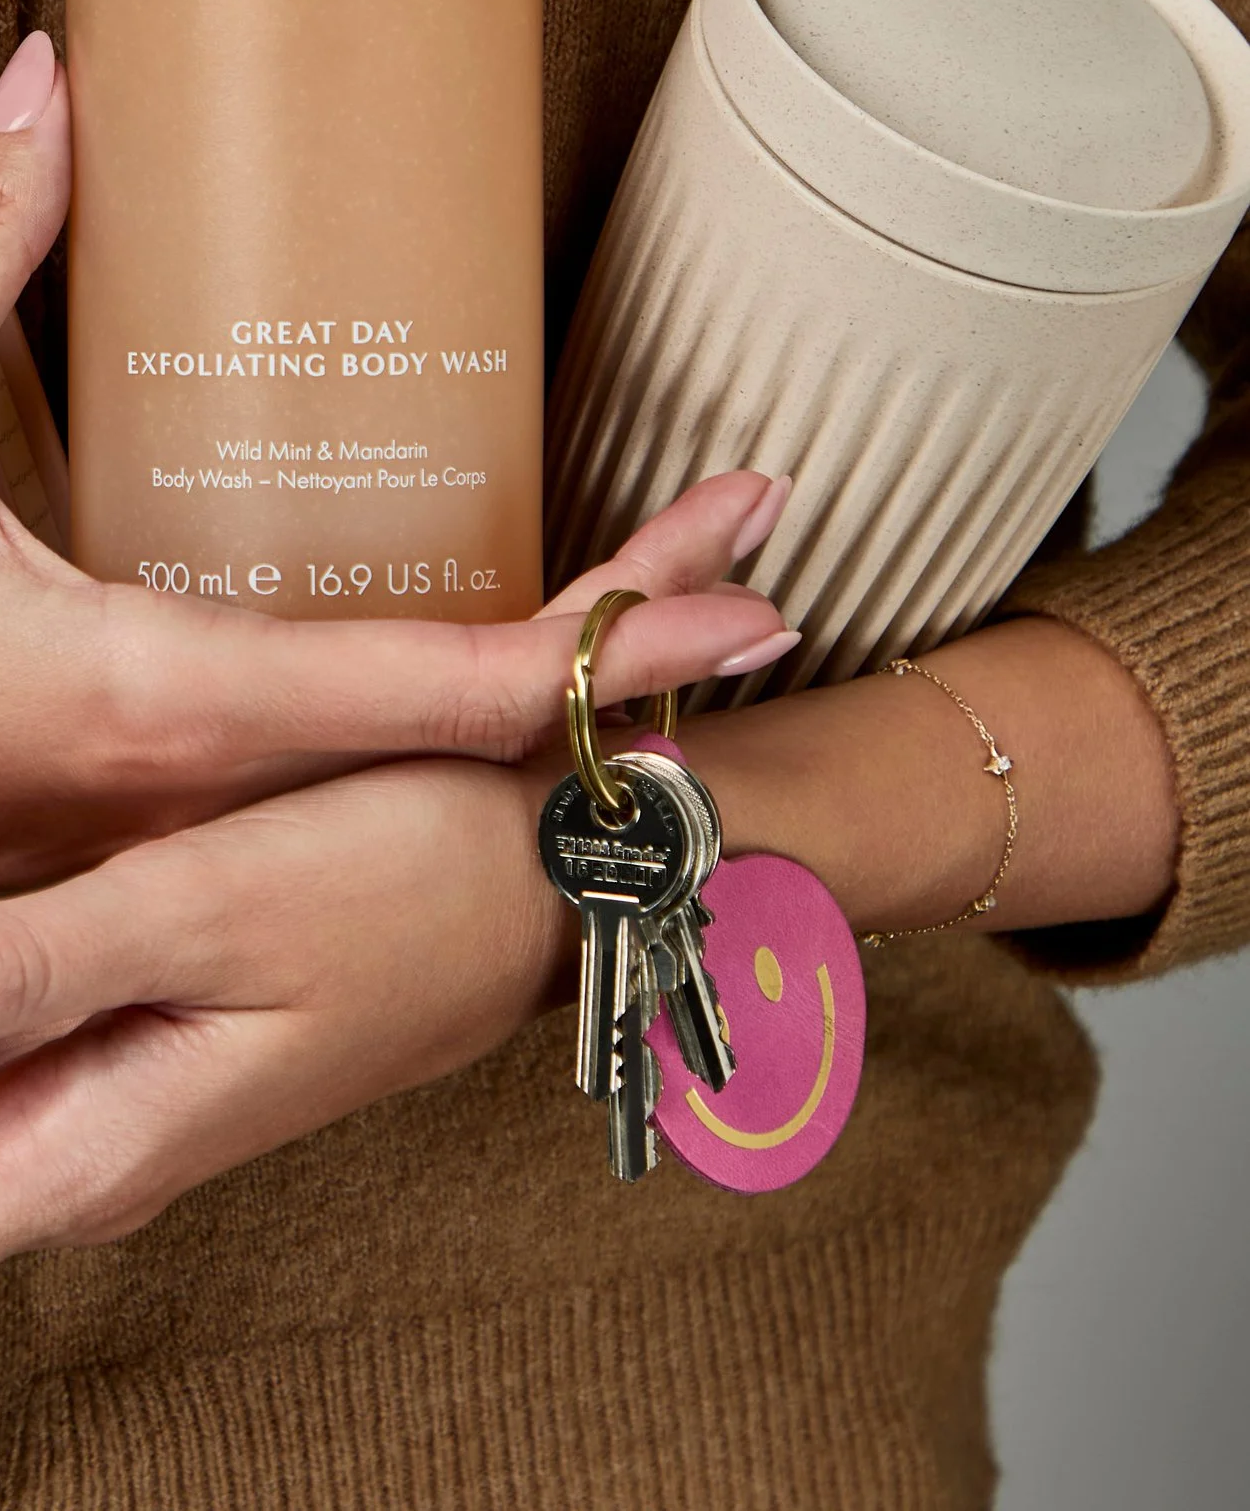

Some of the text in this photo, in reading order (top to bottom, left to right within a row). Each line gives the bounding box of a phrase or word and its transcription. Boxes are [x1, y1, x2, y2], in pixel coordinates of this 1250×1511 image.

[230, 320, 414, 345] GREAT DAY
[127, 349, 507, 377] EXFOLIATING BODY WASH
[216, 439, 428, 461] Wild Mint & Mandarin
[151, 467, 195, 494] Body
[198, 468, 253, 489] Wash
[277, 470, 373, 495] Nettoyant
[377, 468, 415, 488] Pour
[420, 467, 438, 488] Le
[442, 466, 487, 490] Corps
[137, 561, 190, 595] 500
[199, 564, 239, 596] mL
[307, 563, 373, 596] 16.9
[387, 563, 432, 595] US
[443, 558, 465, 593] fl.
[469, 567, 502, 591] oz.
